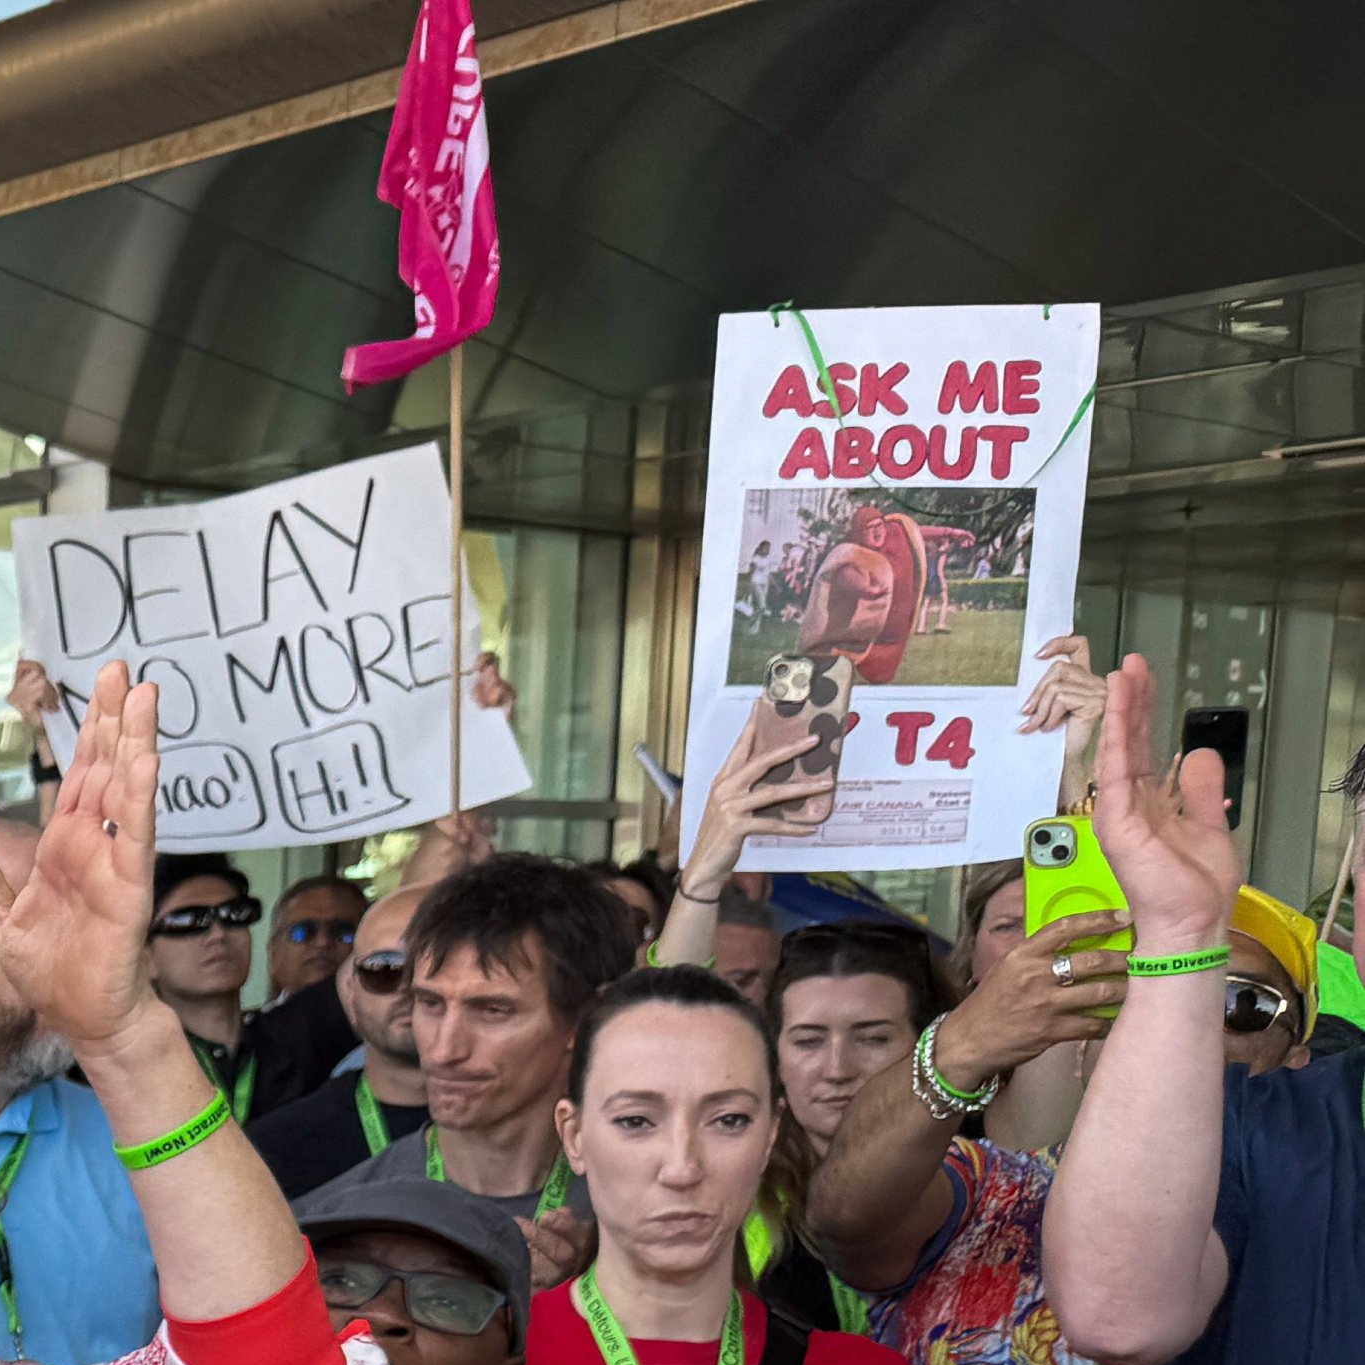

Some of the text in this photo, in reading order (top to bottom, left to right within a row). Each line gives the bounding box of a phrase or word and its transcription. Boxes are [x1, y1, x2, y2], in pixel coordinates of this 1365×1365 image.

[763, 359, 1042, 419] ASK ME
[778, 425, 1030, 481] ABOUT
[49, 478, 376, 661] DELAY
[225, 594, 473, 728] MORE
[885, 711, 976, 770] T4
[289, 742, 370, 822] Hi!
